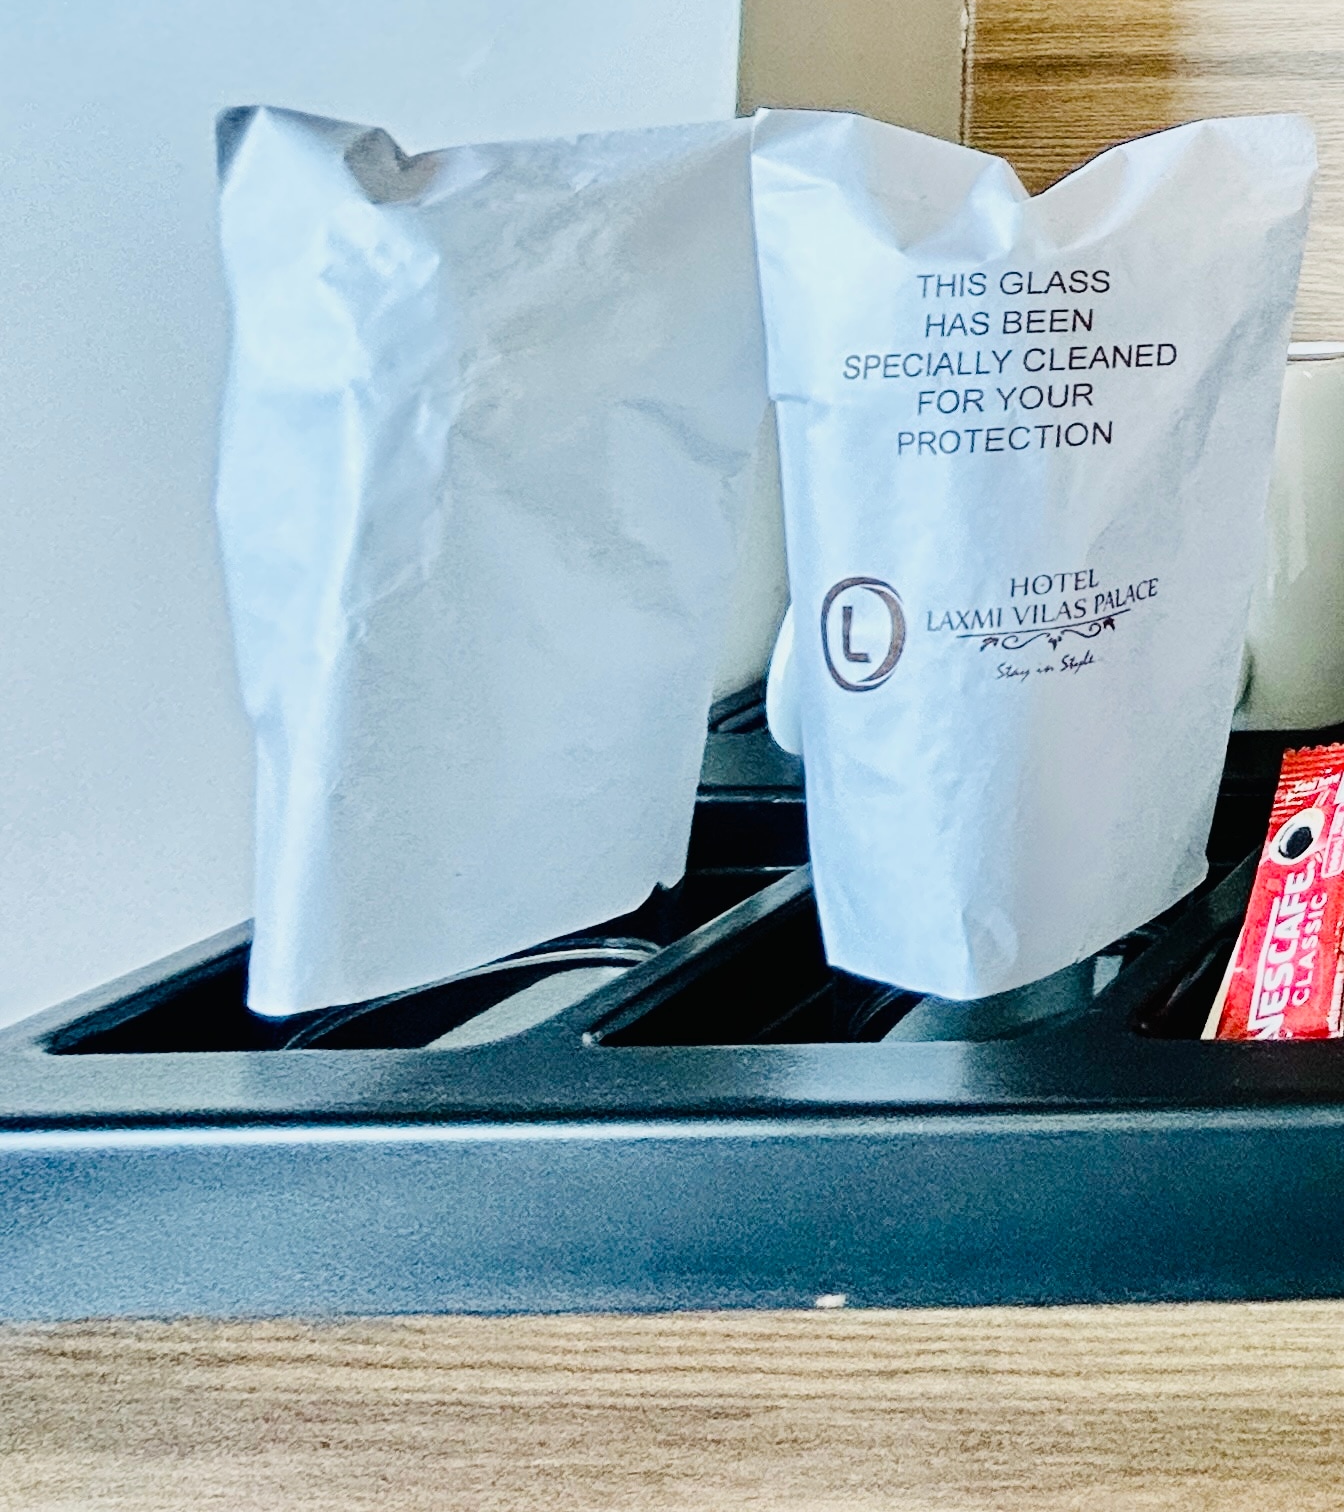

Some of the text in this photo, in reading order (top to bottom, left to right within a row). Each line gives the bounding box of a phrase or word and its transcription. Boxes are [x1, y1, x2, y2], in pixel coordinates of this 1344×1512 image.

[917, 270, 1111, 299] THIS GLASS
[925, 308, 1094, 338] HAS BEEN
[843, 343, 1178, 380] SPECIALLY CLEANED
[917, 383, 1094, 415] FOR YOUR
[897, 421, 1113, 456] PROTECTION
[1010, 568, 1100, 597] HOTEL
[926, 577, 1159, 632] LAXMI VILAS PALACE
[996, 662, 1031, 682] Stay
[1291, 892, 1328, 1007] CLASSIC
